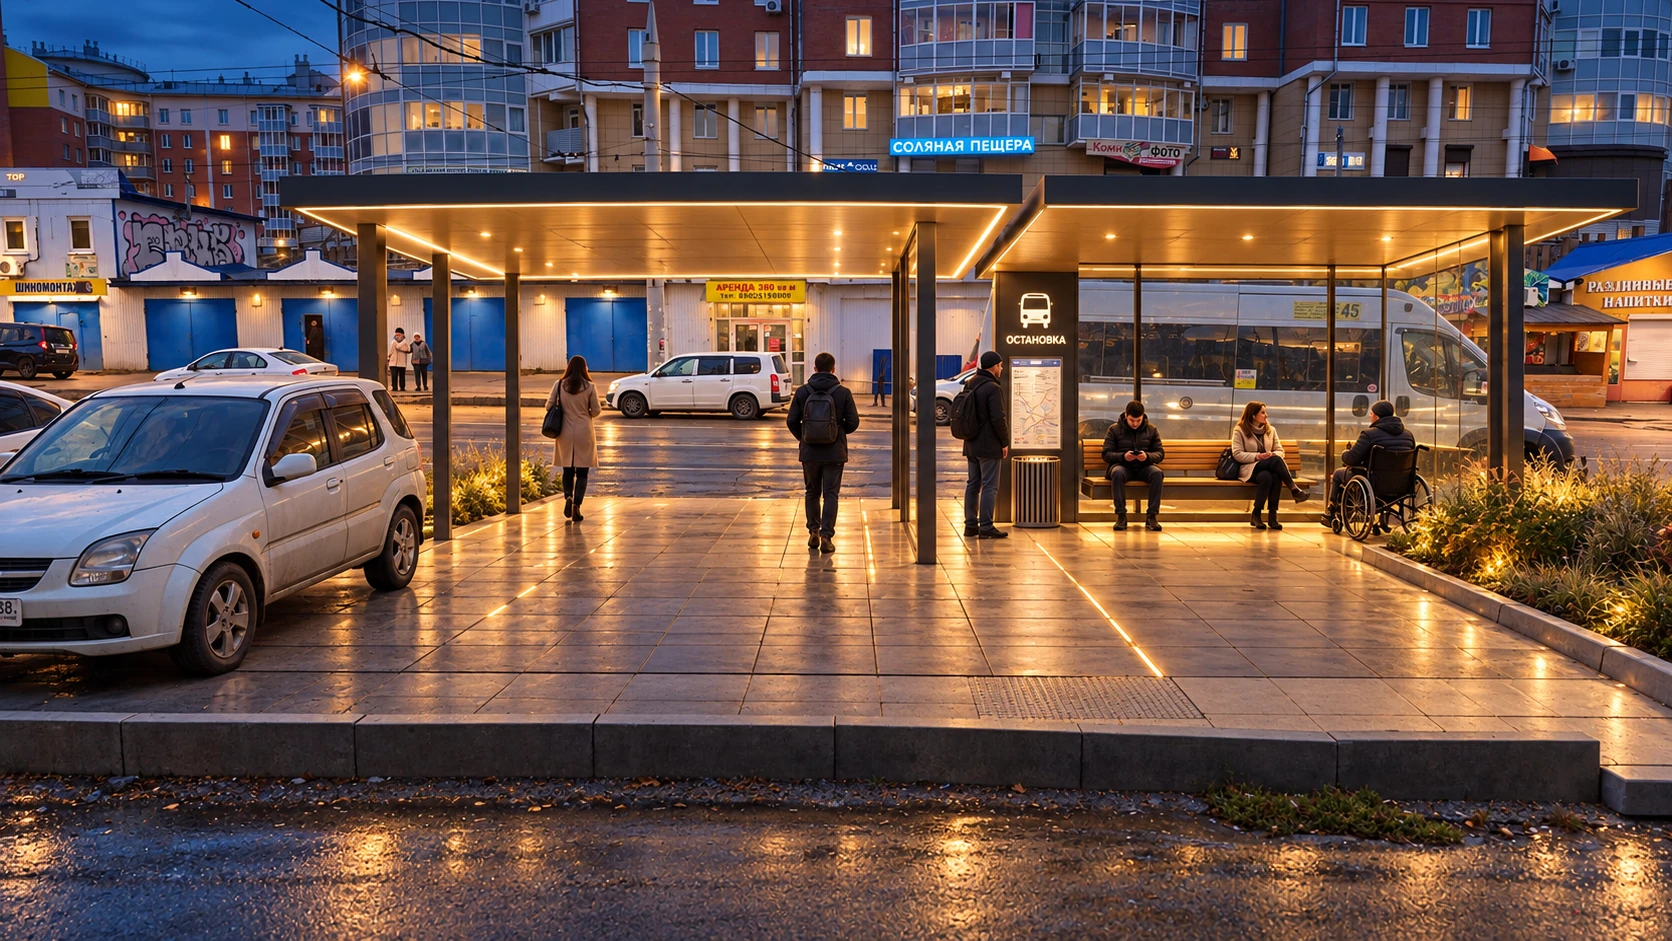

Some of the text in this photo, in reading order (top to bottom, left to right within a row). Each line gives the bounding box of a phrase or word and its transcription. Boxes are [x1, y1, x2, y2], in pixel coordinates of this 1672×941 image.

[892, 139, 1032, 153] СОЛЯНАЯ ПЕЩЕРА
[716, 283, 755, 292] АРЕНДА
[1341, 303, 1359, 318] 45
[1006, 335, 1066, 345] ОСТАНОВКА
